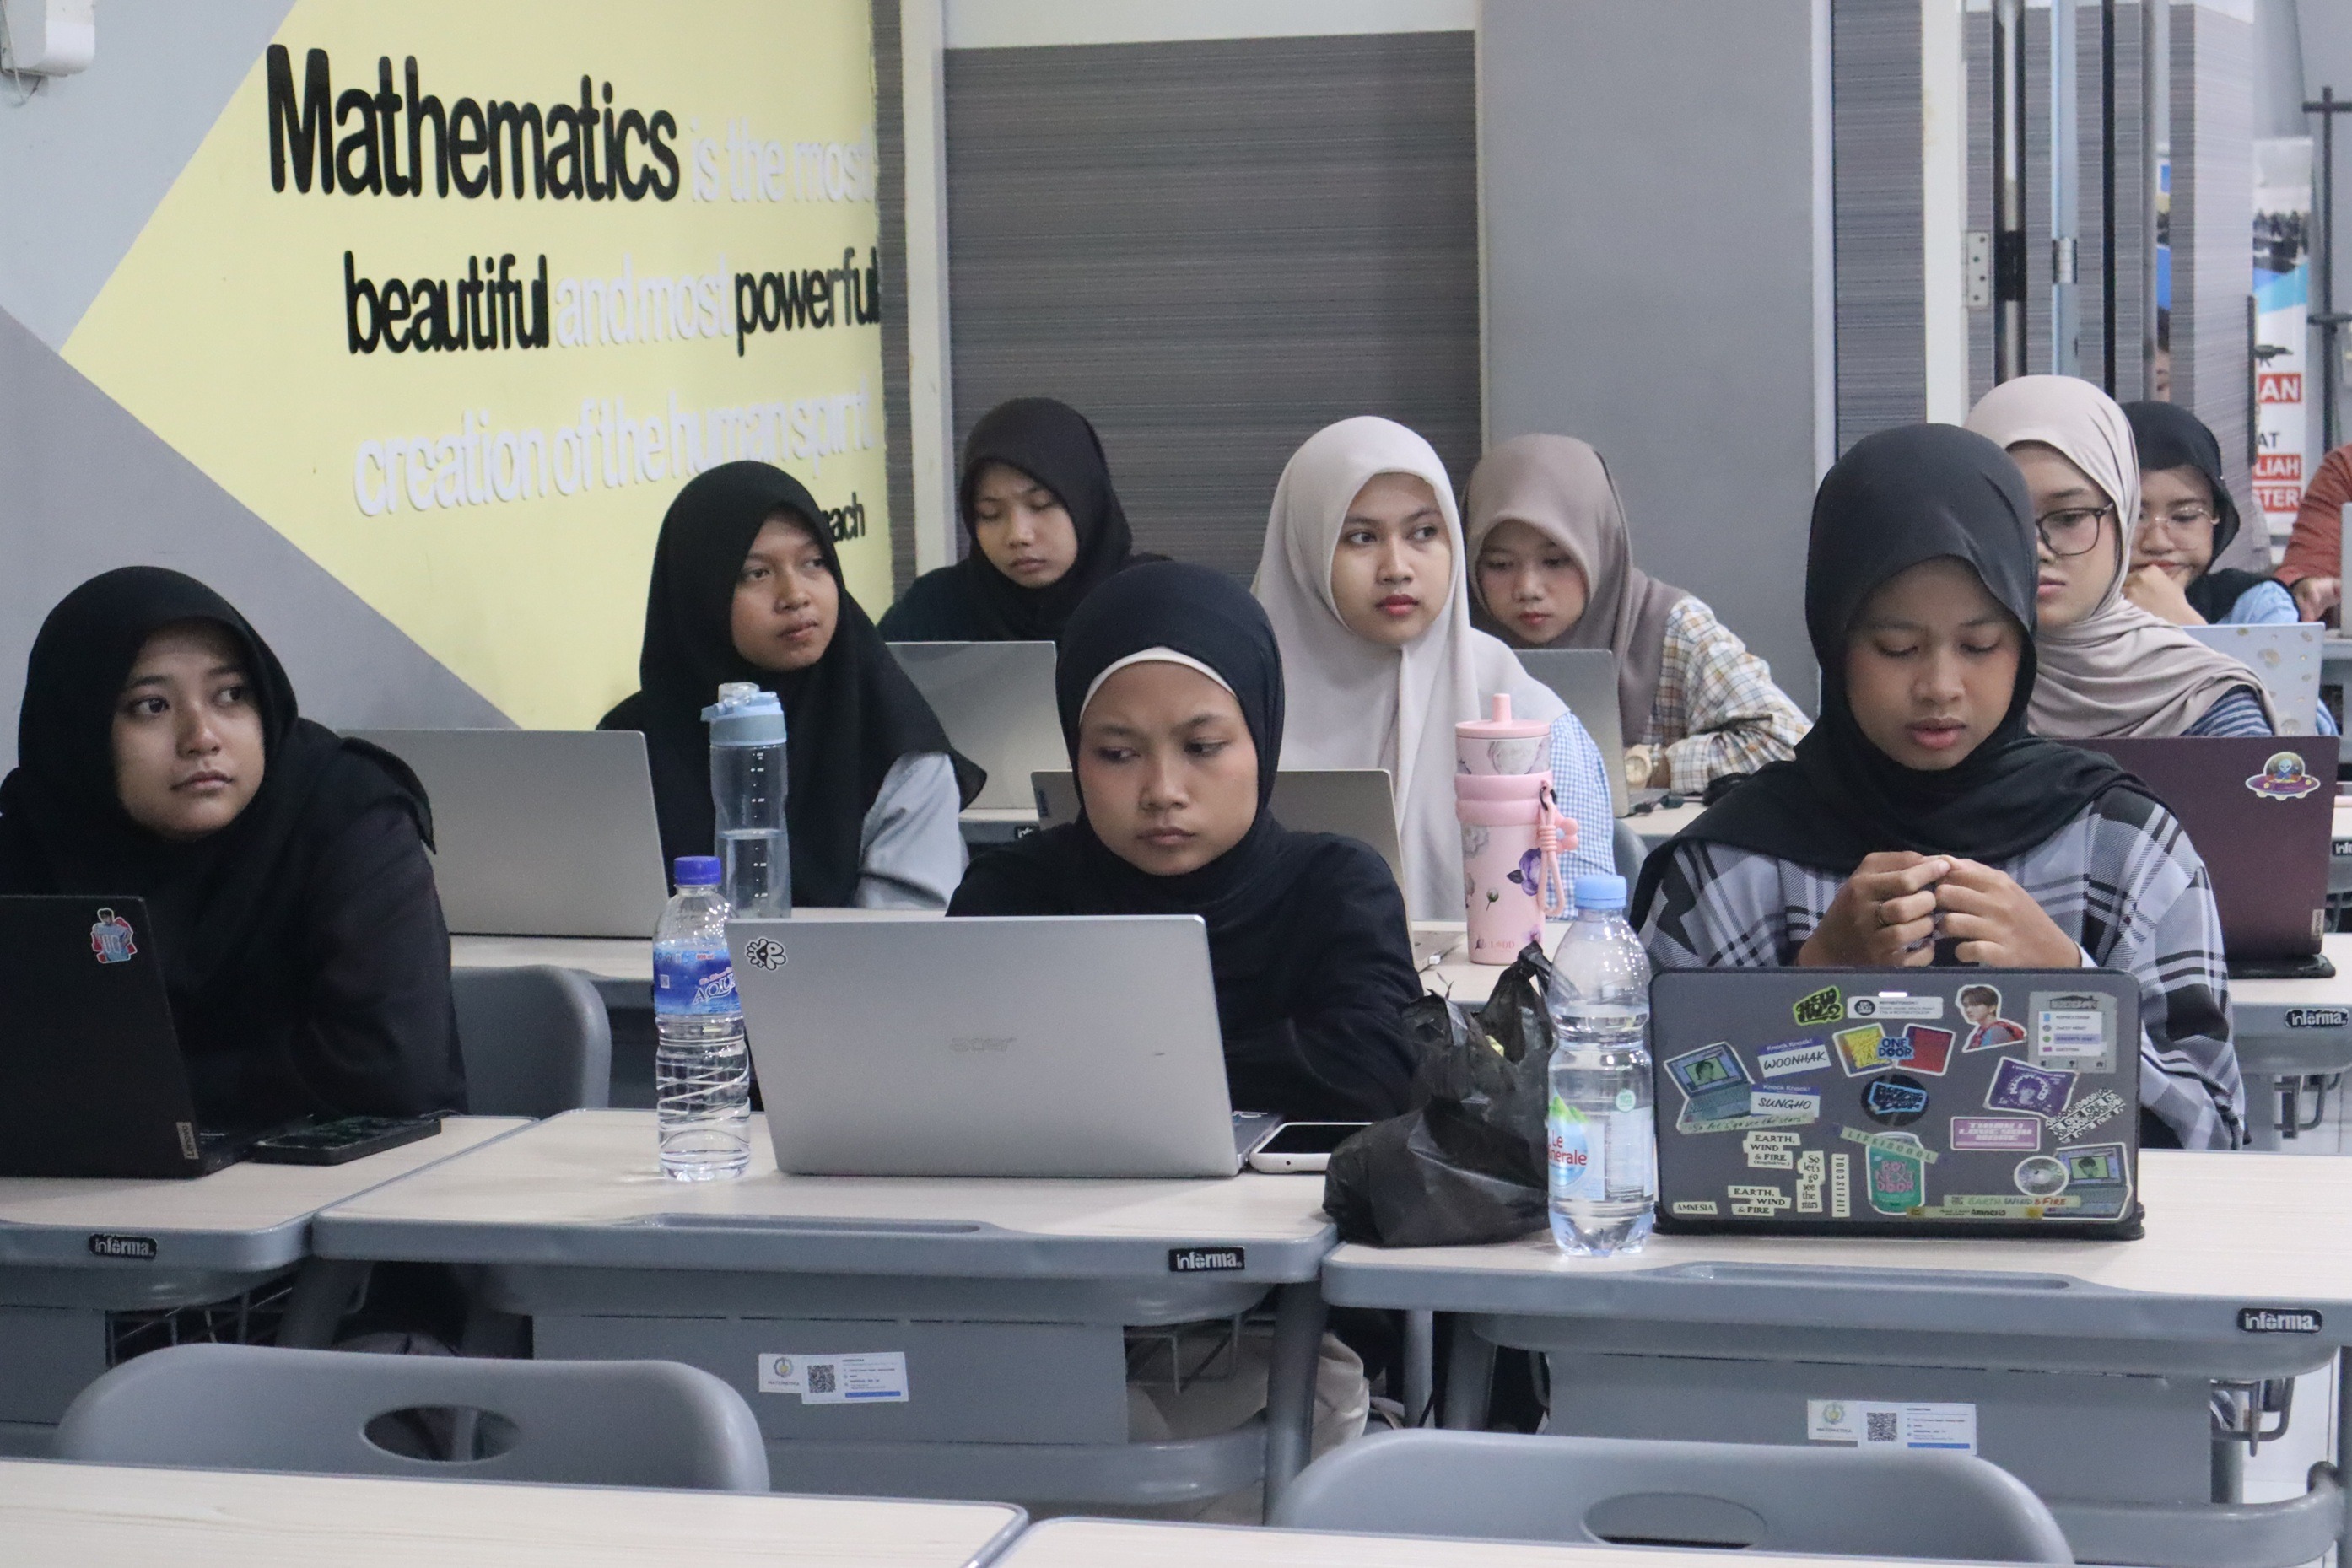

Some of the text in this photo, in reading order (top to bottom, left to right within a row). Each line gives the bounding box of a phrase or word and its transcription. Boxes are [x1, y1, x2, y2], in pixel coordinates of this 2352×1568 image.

[266, 44, 875, 202] Mathematics is the most
[343, 246, 880, 357] beautiful and most powerful
[2261, 378, 2299, 401] AN
[353, 374, 874, 517] creation of the human spirit
[2258, 432, 2279, 447] AT
[2255, 459, 2300, 476] LIAH
[820, 492, 865, 541] ach
[692, 973, 736, 1006] AQU
[1881, 1038, 1907, 1048] ONE
[1764, 1051, 1826, 1070] WOONHAK
[1878, 1048, 1912, 1058] DOOR
[1758, 1097, 1812, 1110] SUNGHO
[1552, 1129, 1563, 1148] Le
[1547, 1149, 1587, 1166] nerale
[1808, 1155, 1820, 1164] So
[1804, 1162, 1820, 1172] let's
[1808, 1174, 1819, 1183] go
[1836, 1156, 1845, 1213] LIFEISCOOL
[1802, 1191, 1815, 1199] the
[1177, 1252, 1237, 1269] informa
[2245, 1312, 2313, 1330] informa
